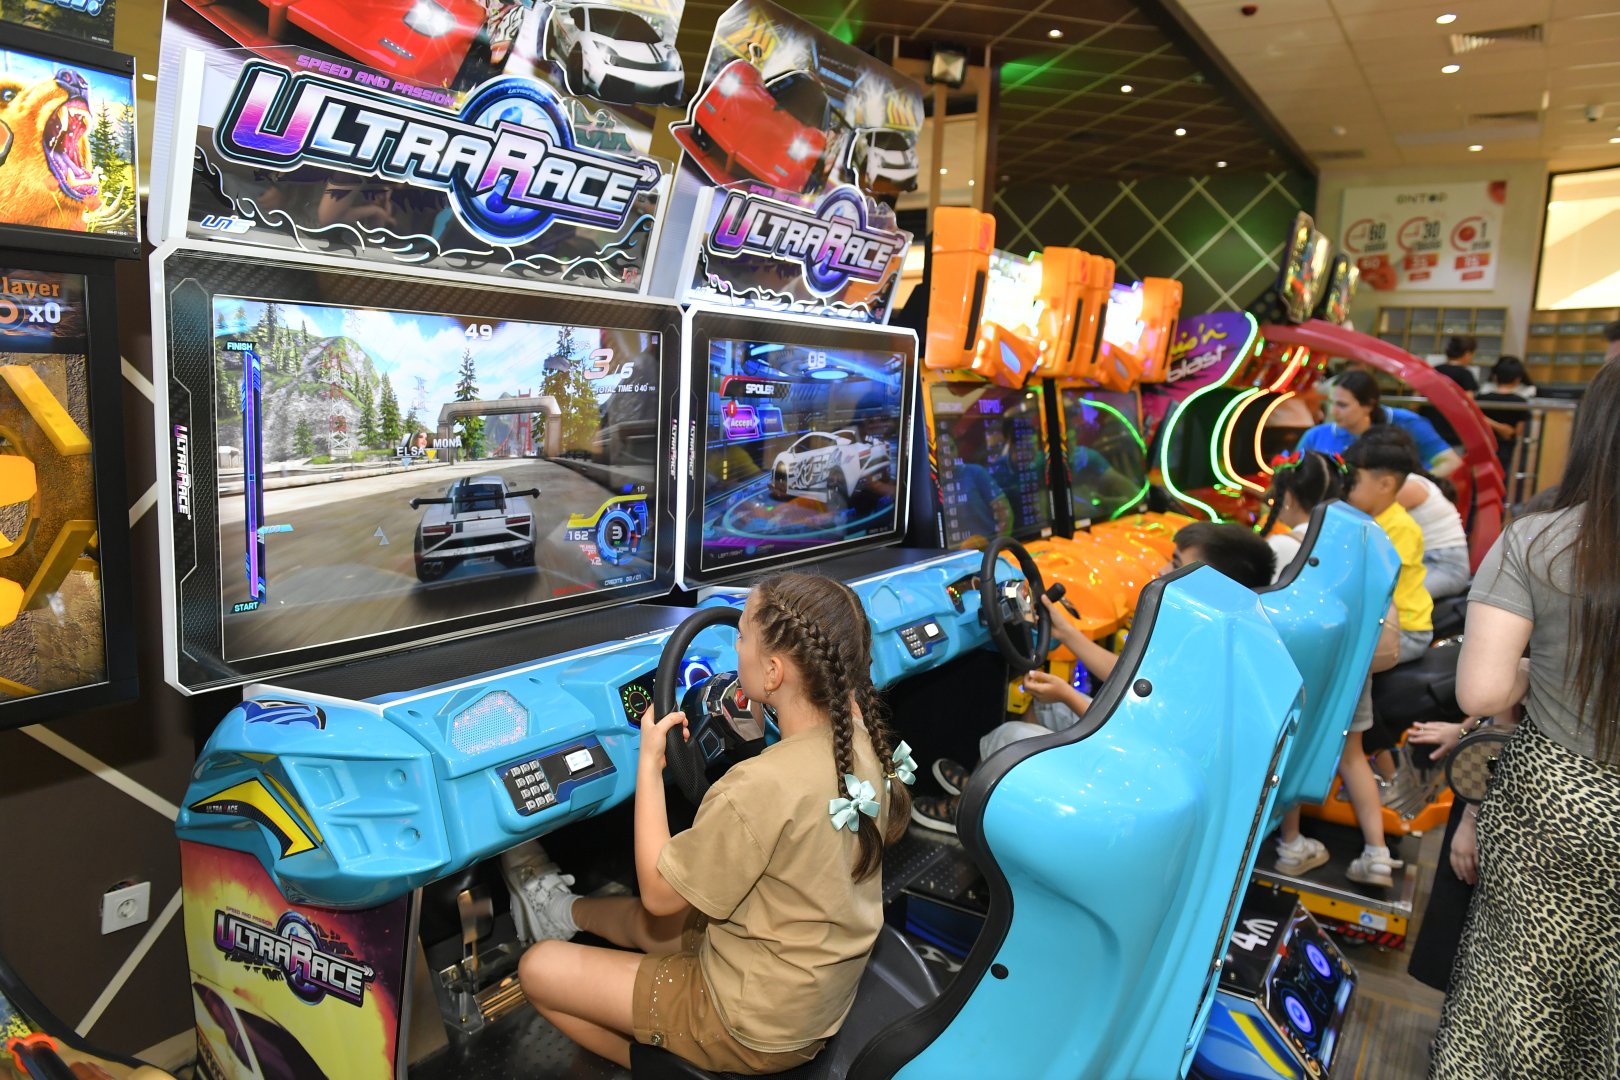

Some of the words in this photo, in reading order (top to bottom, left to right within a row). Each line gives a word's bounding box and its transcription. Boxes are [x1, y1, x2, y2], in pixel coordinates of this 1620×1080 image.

[296, 54, 353, 79] SPEED
[354, 72, 390, 89] AND
[392, 81, 456, 107] PASSION
[464, 323, 493, 341] 49
[227, 342, 253, 350] FINISH
[617, 384, 633, 393] TIME
[745, 383, 775, 395] SPOILER
[432, 436, 463, 448] MONA
[396, 446, 425, 456] ELSA
[174, 424, 191, 515] ULTRARACE
[568, 531, 589, 541] 162
[612, 525, 623, 540] 3
[234, 601, 259, 612] START
